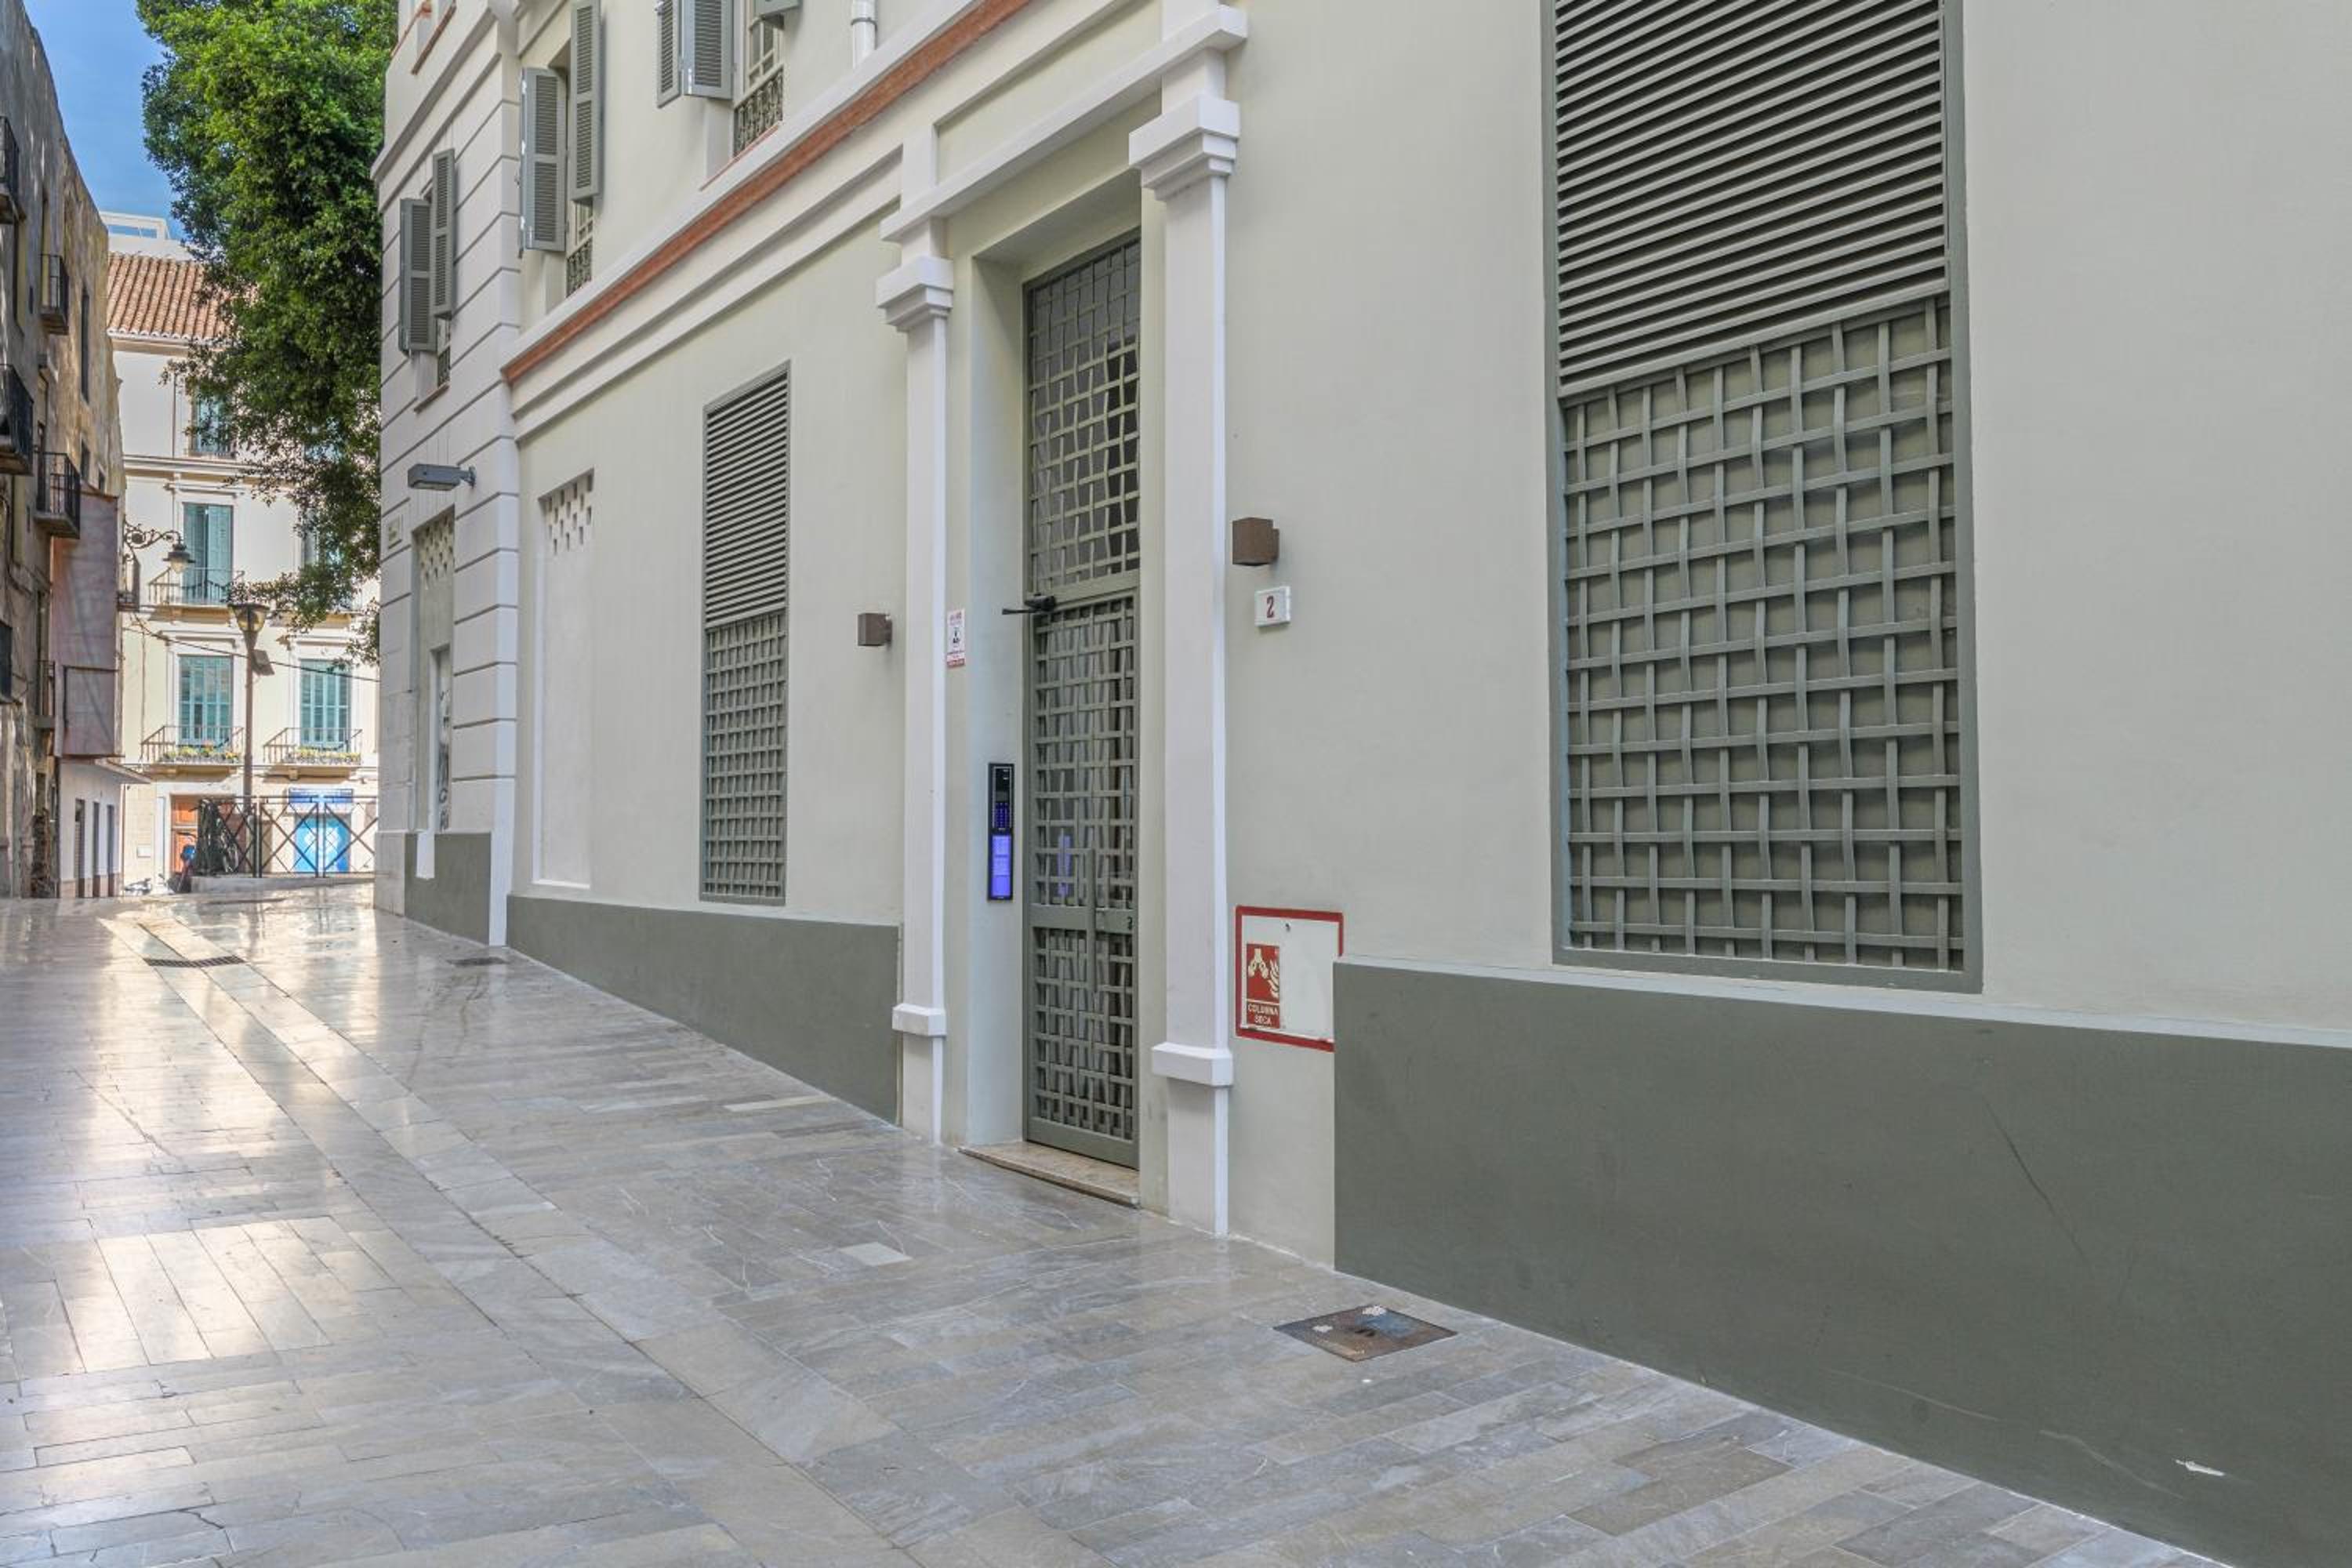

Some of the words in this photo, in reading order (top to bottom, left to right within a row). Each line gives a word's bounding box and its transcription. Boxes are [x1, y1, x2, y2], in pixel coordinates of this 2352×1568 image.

[1266, 595, 1274, 619] 2
[1247, 1004, 1279, 1016] COLUMNA
[1254, 1014, 1272, 1025] SECA
